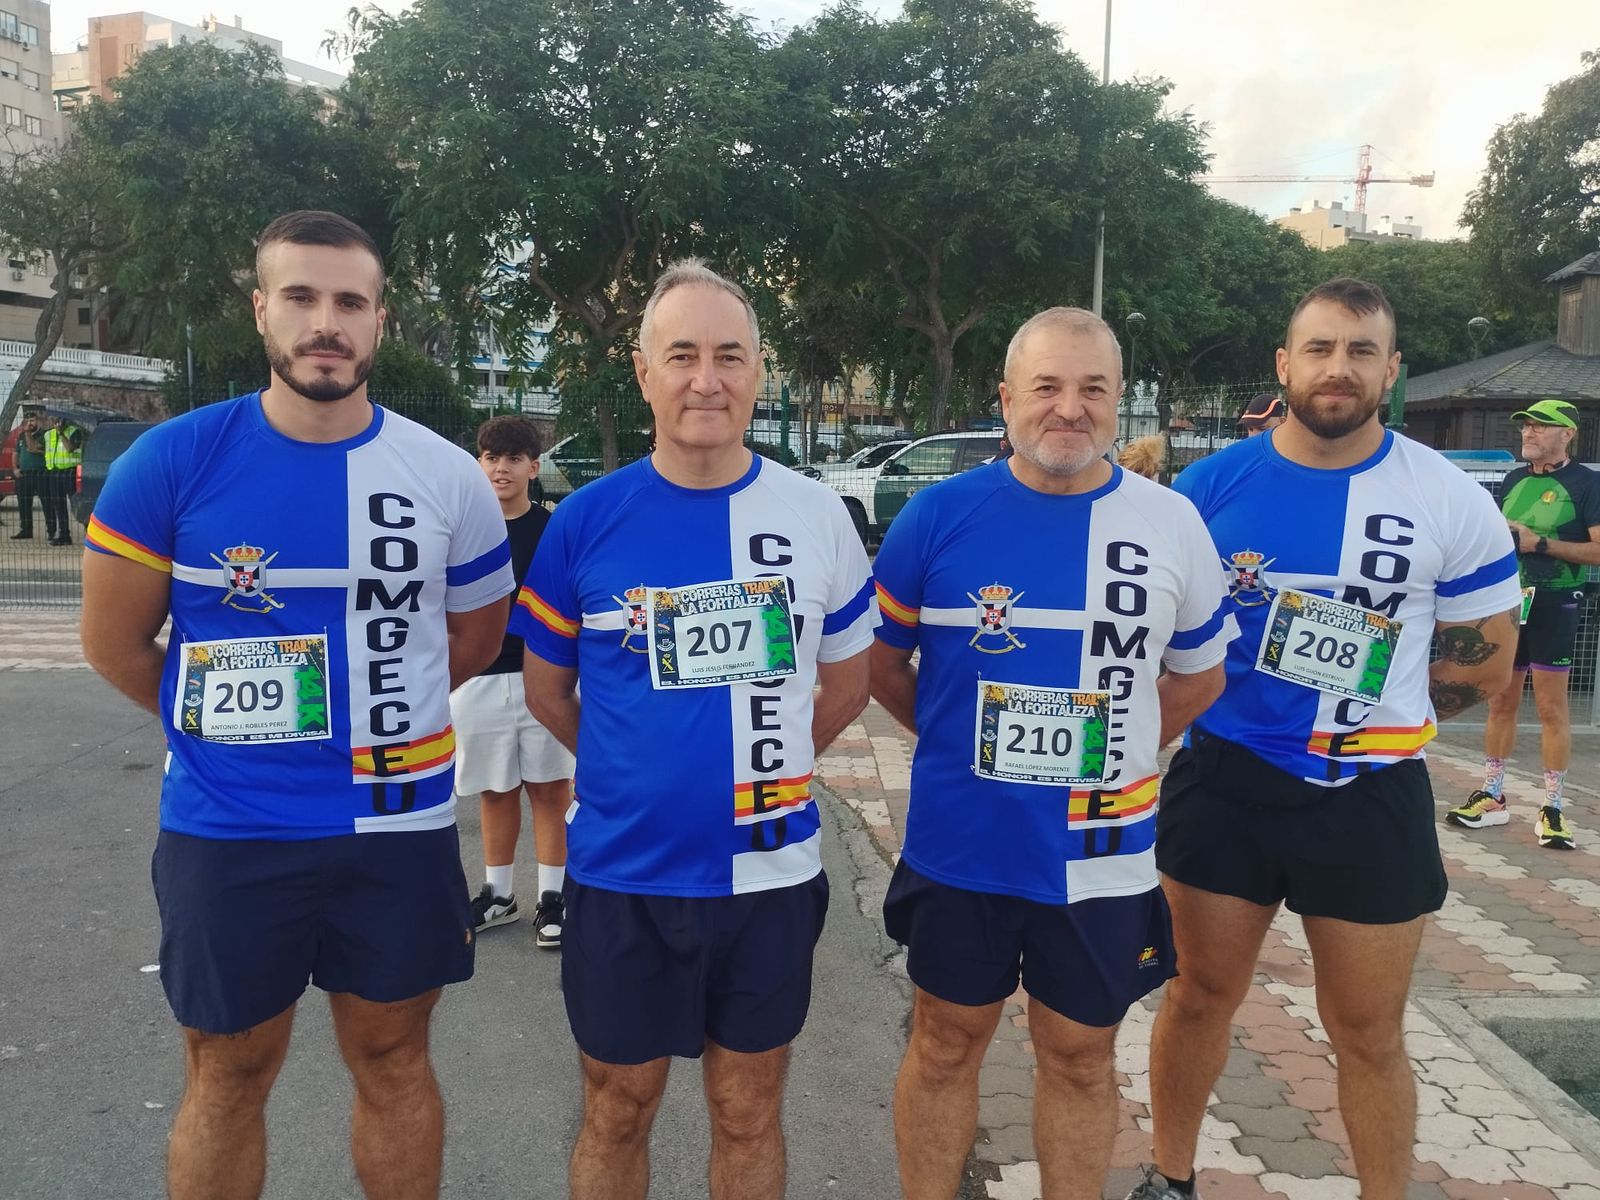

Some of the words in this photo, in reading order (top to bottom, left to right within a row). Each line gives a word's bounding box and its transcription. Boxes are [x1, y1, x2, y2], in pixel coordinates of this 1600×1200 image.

[681, 584, 741, 602] CORRERAS
[743, 580, 772, 594] TRAIL
[680, 603, 698, 616] LA
[700, 594, 773, 613] FORTALEZA
[1308, 599, 1365, 623] CORRERAS
[1302, 608, 1319, 621] LA
[1319, 612, 1385, 640] FORTALEZA
[214, 641, 275, 657] CORRERAS
[277, 639, 310, 653] TRAIL
[686, 620, 752, 657] 207
[1293, 630, 1359, 669] 208
[213, 658, 229, 671] LA
[230, 653, 309, 669] FORTALEZA
[355, 492, 424, 815] COMGECEU
[677, 676, 722, 685] HONOR
[743, 672, 757, 680] MI
[757, 668, 796, 678] DIVISA
[213, 679, 284, 714] 209
[749, 533, 804, 851] CECEU
[1010, 687, 1069, 704] CORRERAS
[1071, 693, 1099, 706] TRAIL
[1345, 688, 1379, 703] DIVISA
[1007, 701, 1023, 713] LA
[1024, 702, 1096, 718] FORTALEZA
[211, 723, 239, 731] ANTONIO
[244, 721, 268, 729] ROBLES
[268, 732, 283, 740] MI
[284, 730, 327, 739] DIVISA
[1006, 724, 1072, 757] 210
[992, 771, 1033, 780] HONOR
[1068, 776, 1102, 784] DIVISA
